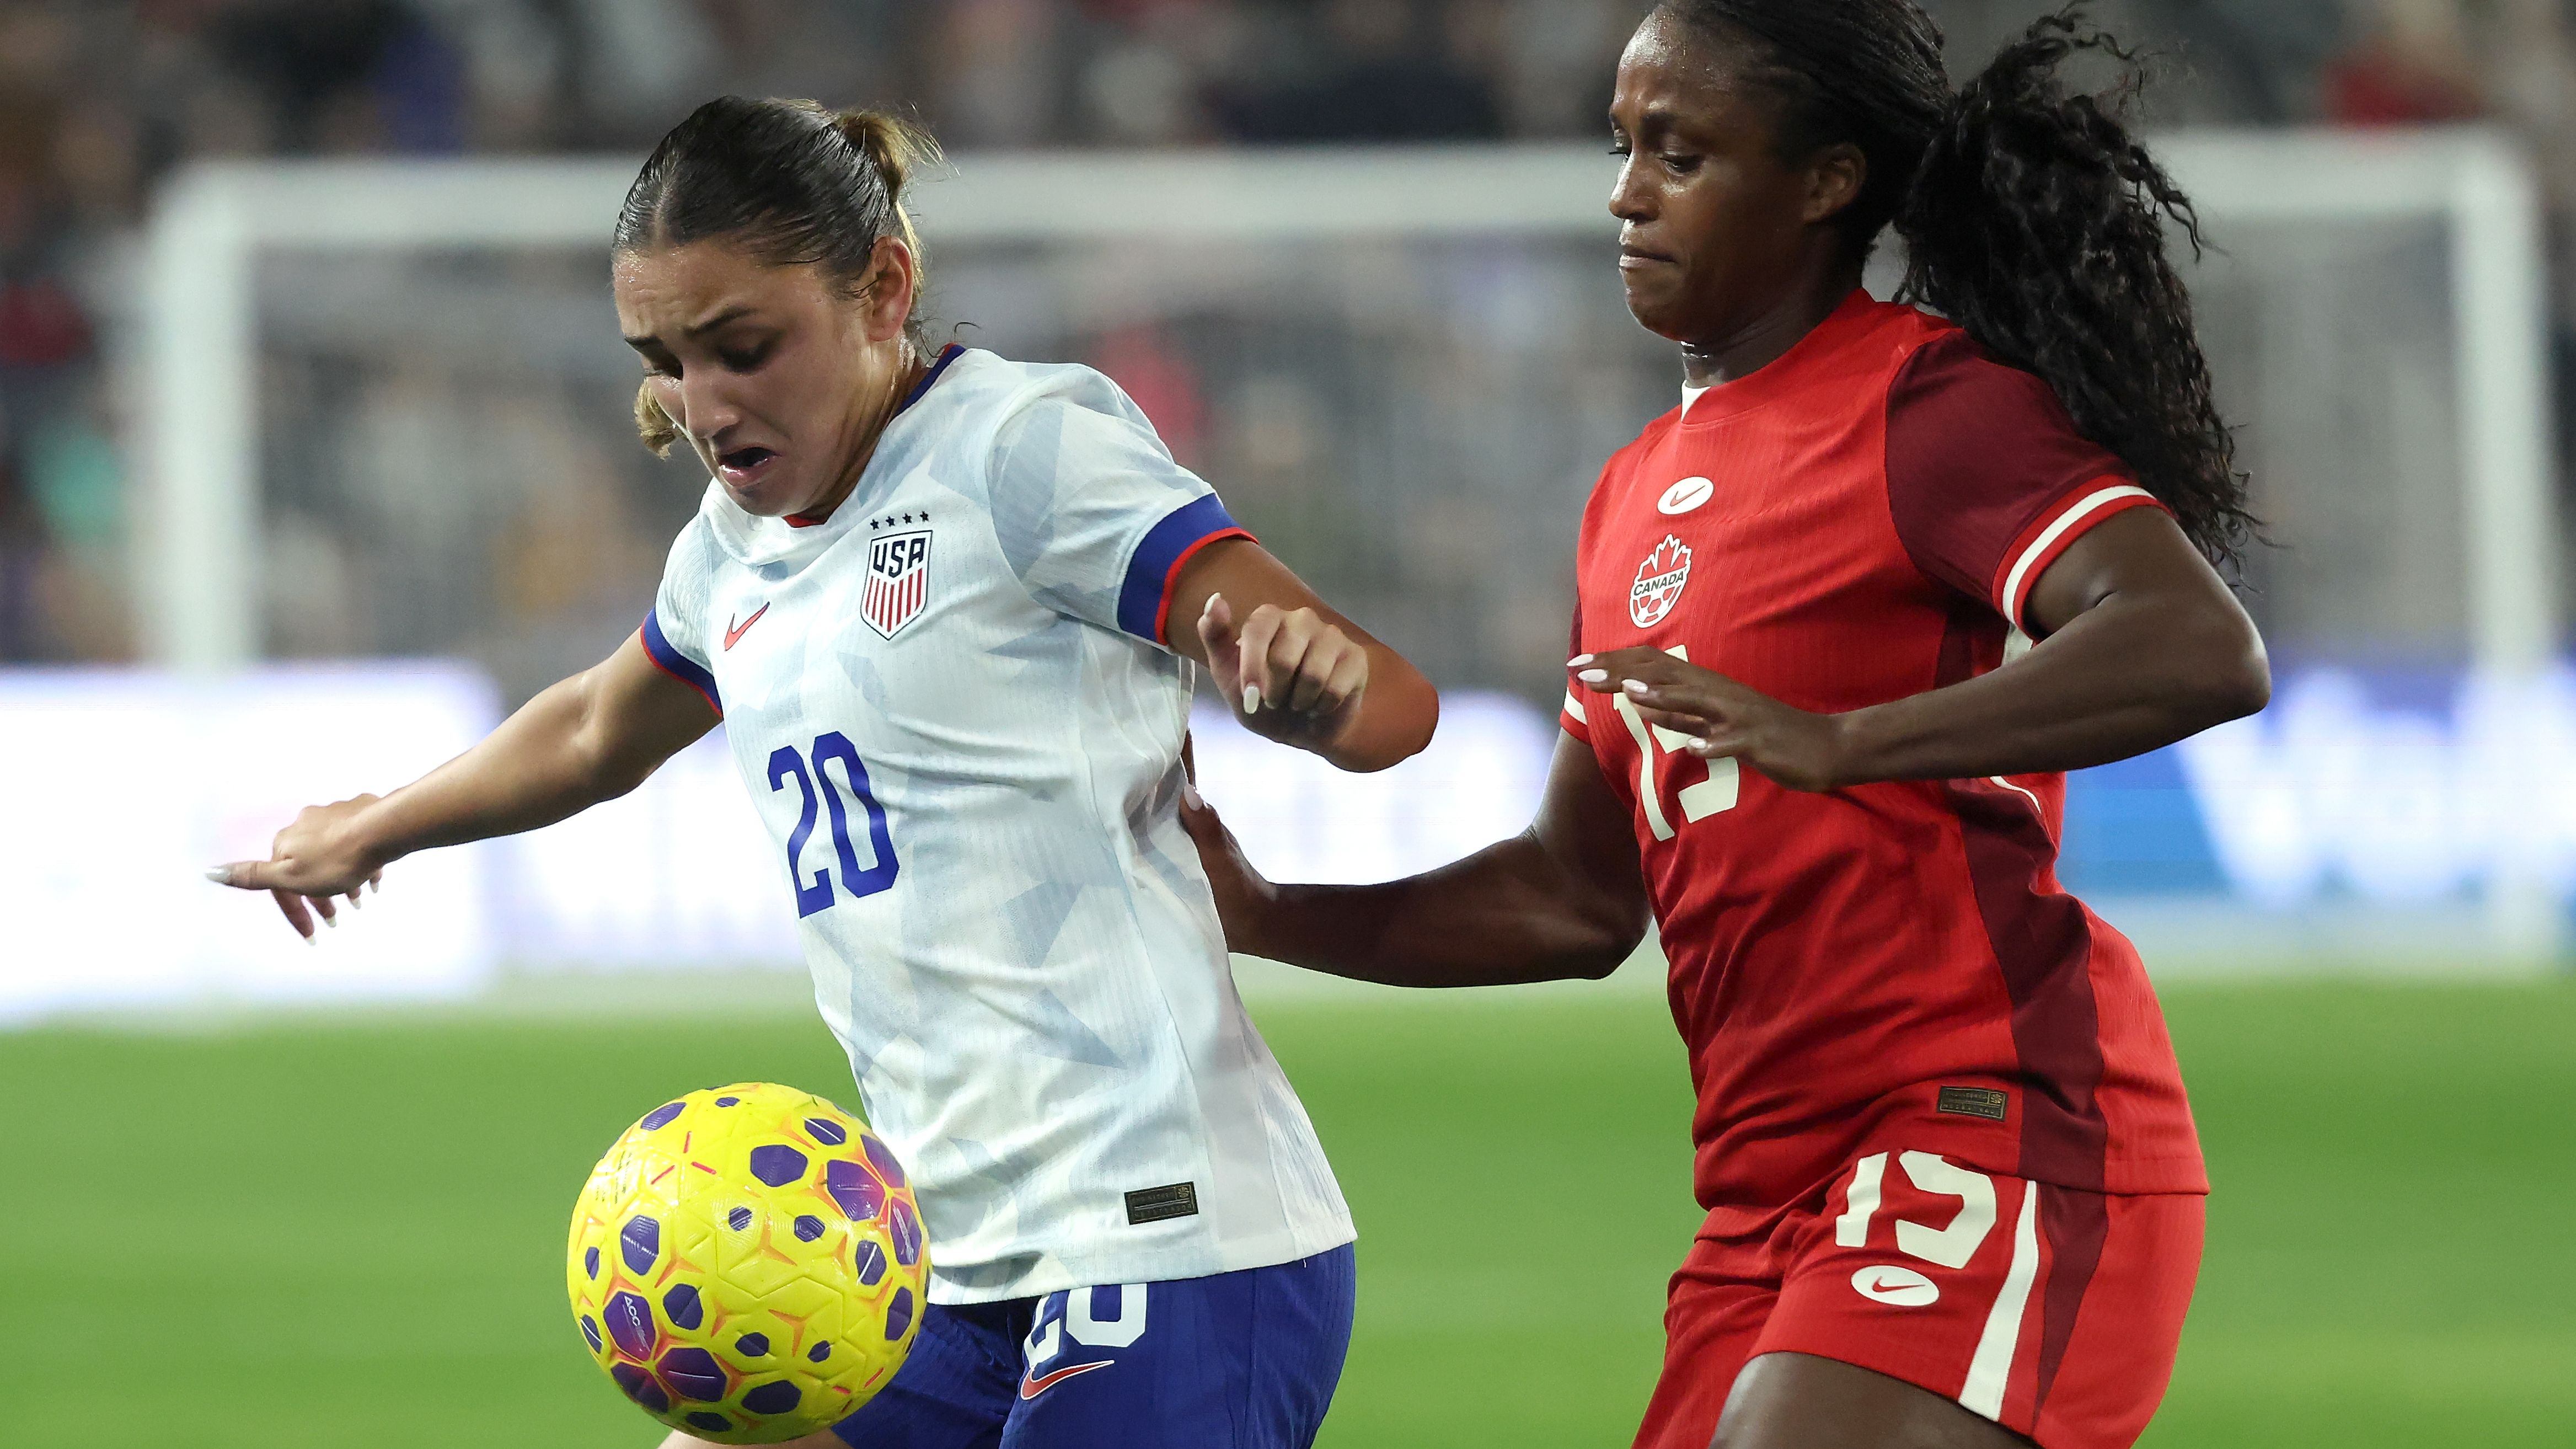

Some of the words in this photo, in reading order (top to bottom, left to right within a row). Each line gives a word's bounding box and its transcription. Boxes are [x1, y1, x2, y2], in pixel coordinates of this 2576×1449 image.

[872, 537, 926, 579] USA
[1633, 570, 1684, 596] CANADA
[767, 731, 900, 919] 20
[624, 1295, 640, 1327] ACC
